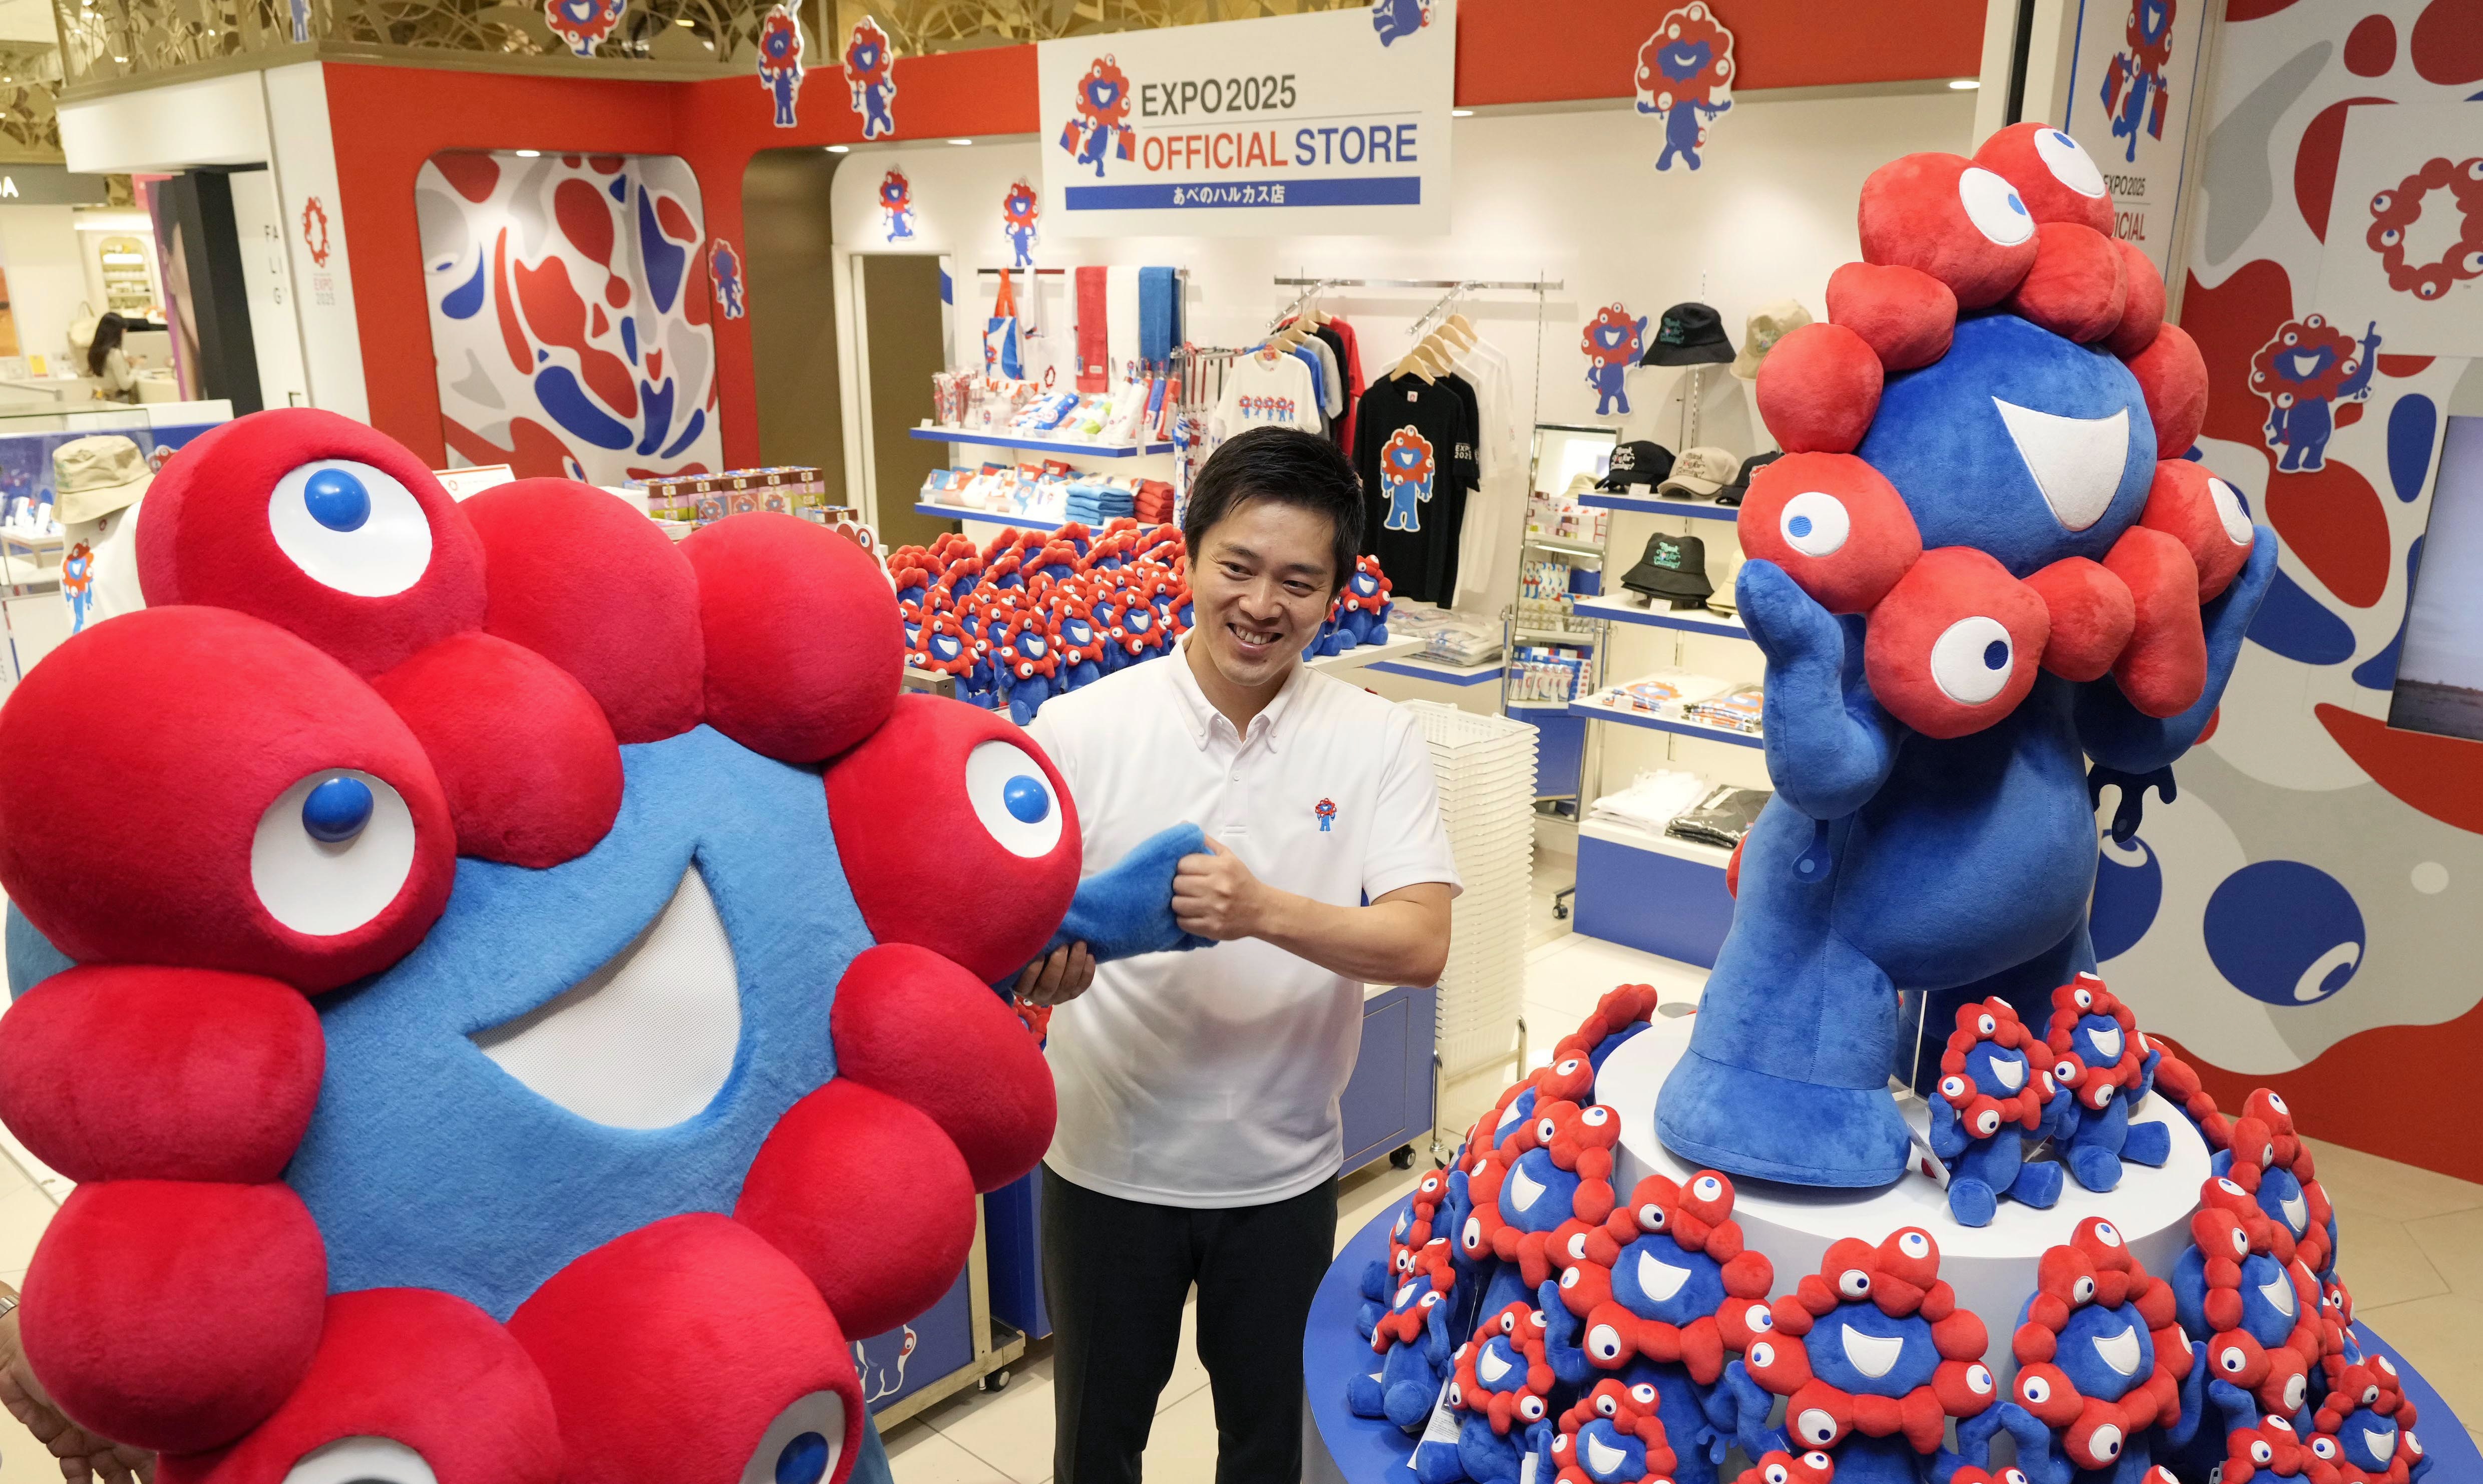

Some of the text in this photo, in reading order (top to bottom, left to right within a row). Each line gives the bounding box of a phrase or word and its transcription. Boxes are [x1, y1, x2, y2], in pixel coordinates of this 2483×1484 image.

[1143, 124, 1417, 171] OFFICIAL STORE
[0, 176, 19, 198] A
[1173, 184, 1285, 205] あべのハルカス店
[2114, 212, 2146, 241] ICIAL
